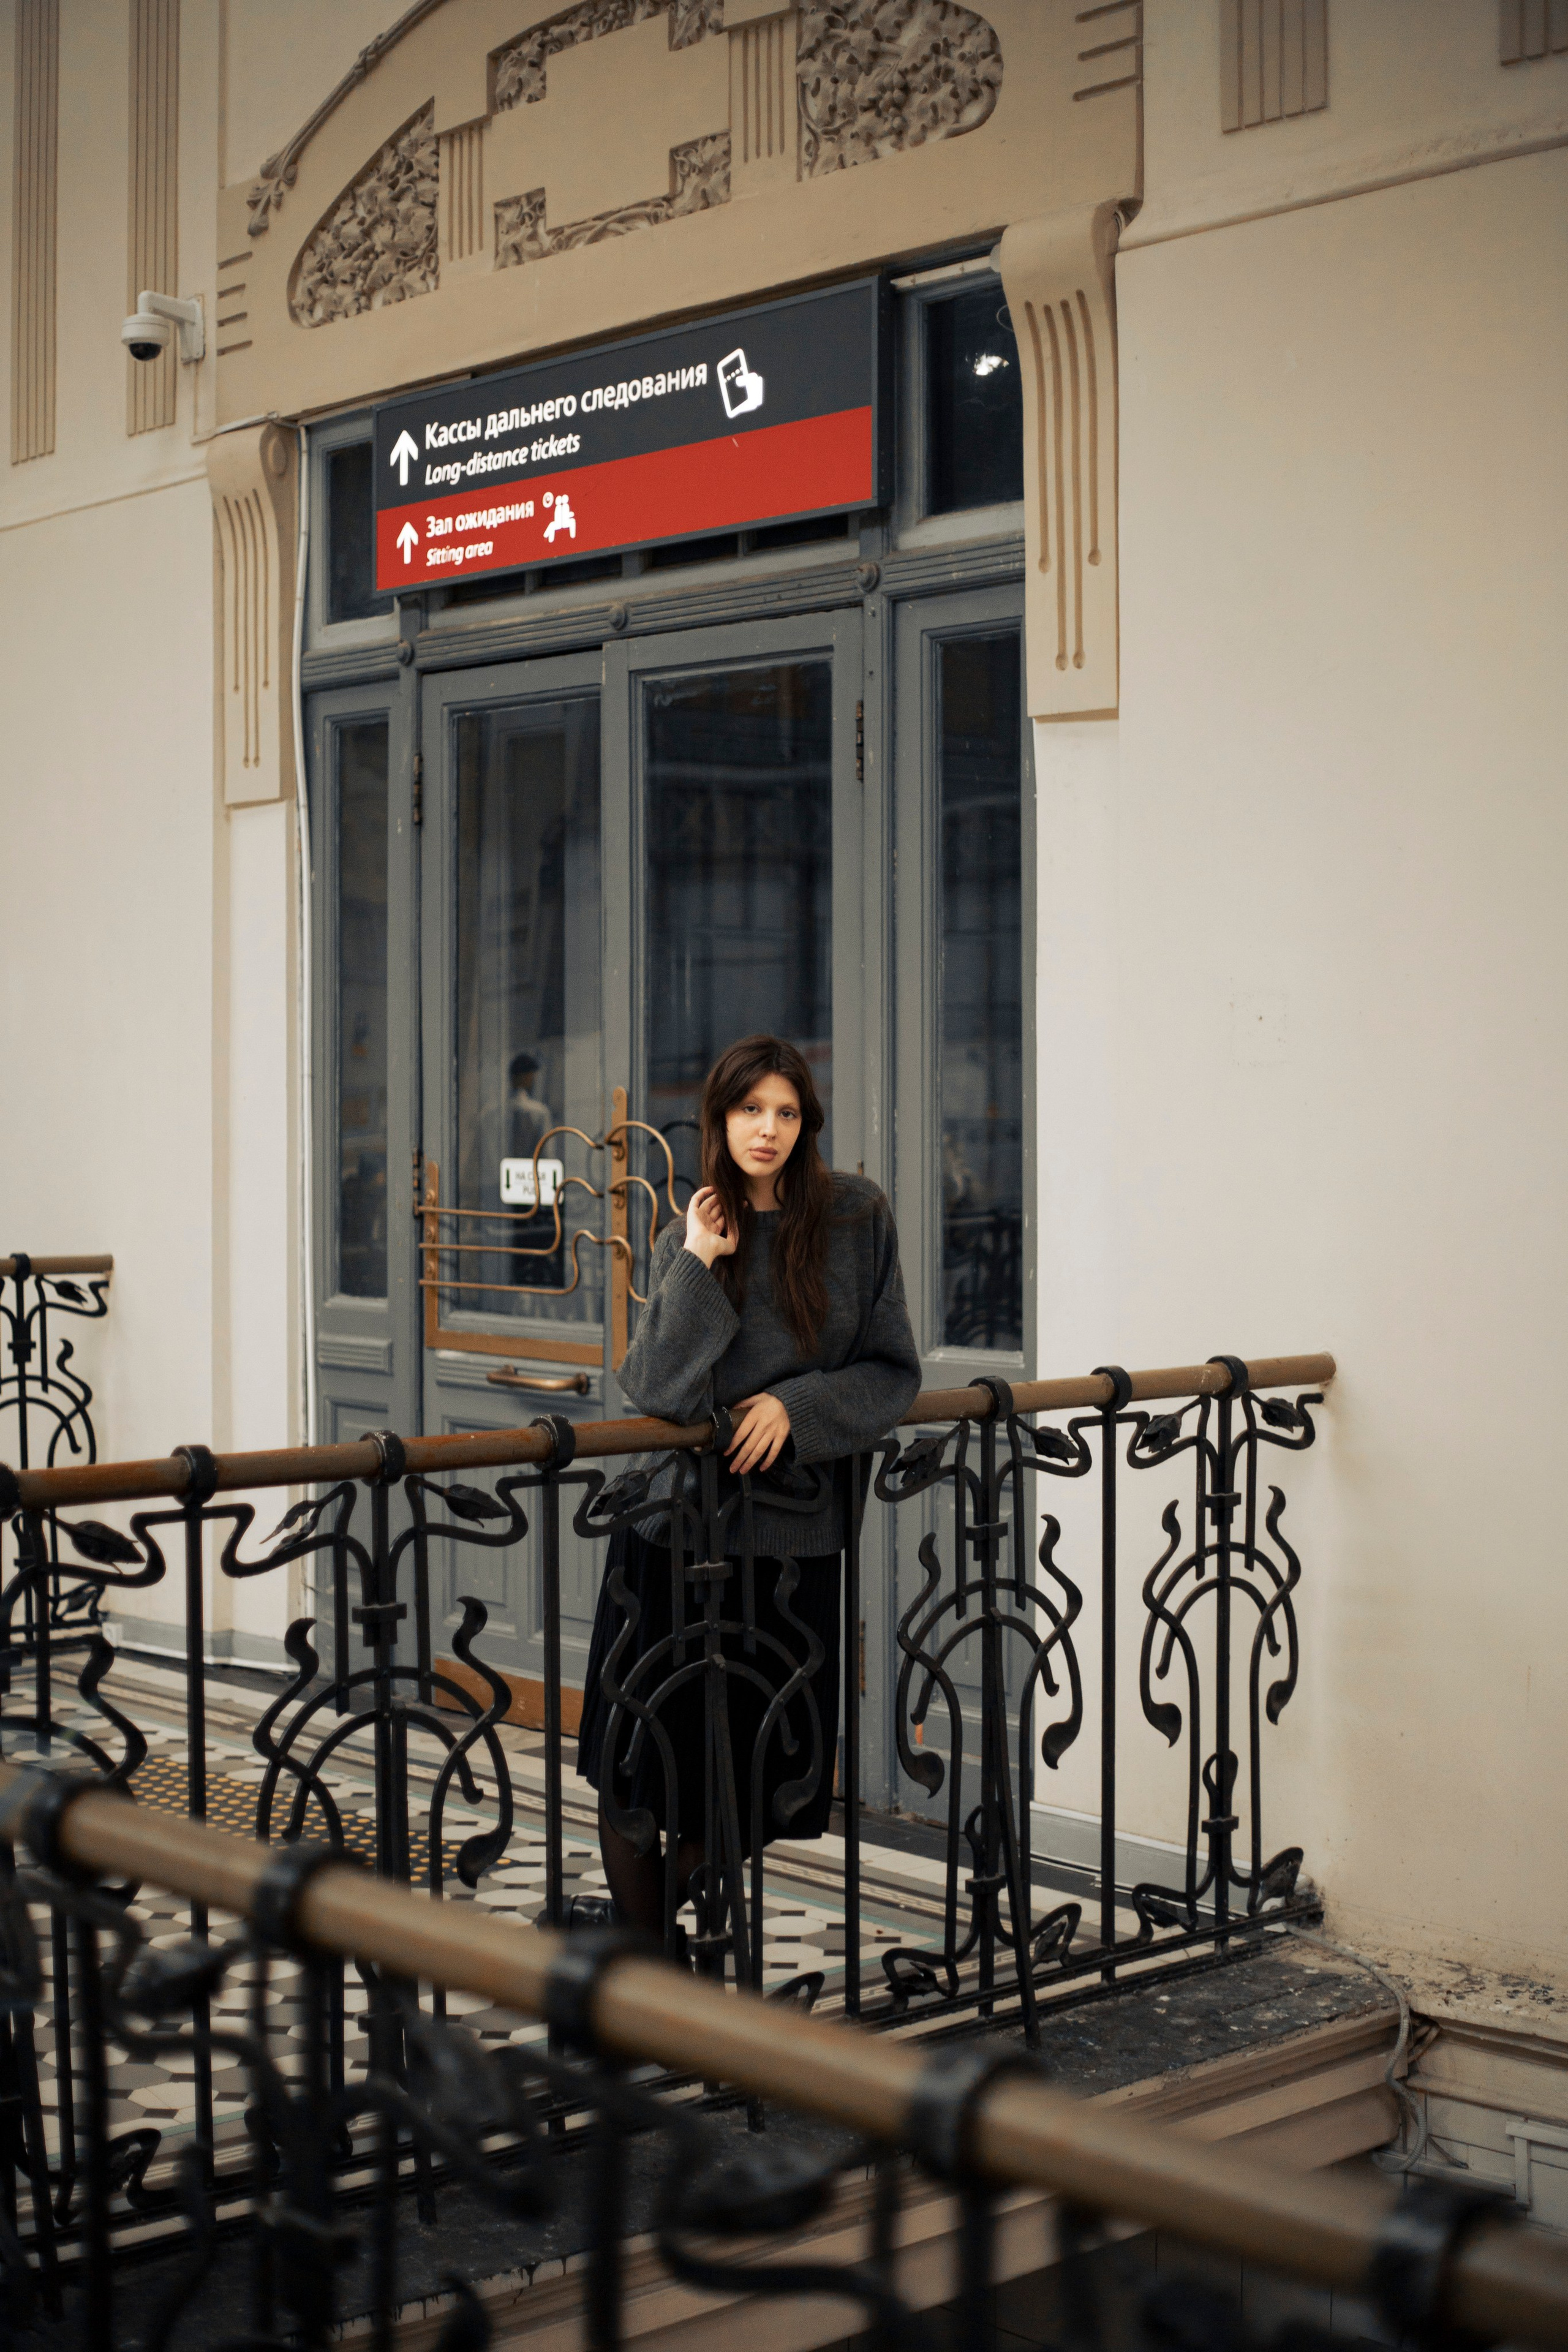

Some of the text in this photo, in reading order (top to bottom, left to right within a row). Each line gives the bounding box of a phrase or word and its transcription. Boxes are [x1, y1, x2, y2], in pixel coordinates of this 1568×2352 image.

[425, 363, 707, 450] Кассы дальнего следования
[424, 433, 581, 486] Long-distance tickets
[426, 500, 534, 538] Зал ожидания
[426, 541, 494, 567] Sitting area
